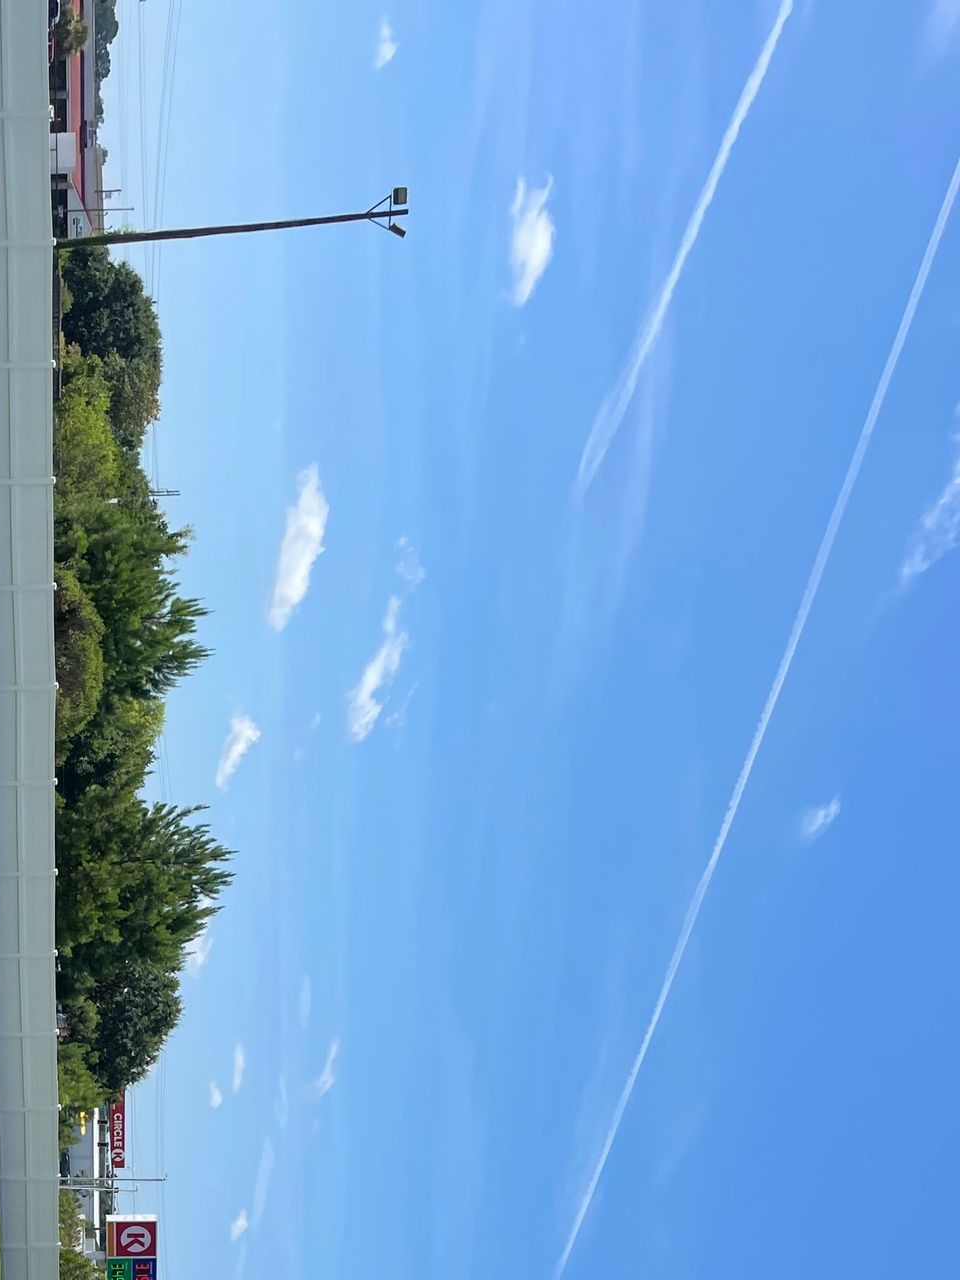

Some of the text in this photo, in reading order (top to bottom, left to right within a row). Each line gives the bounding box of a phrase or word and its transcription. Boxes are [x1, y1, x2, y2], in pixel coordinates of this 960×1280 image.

[112, 1113, 124, 1161] CIRCLE K
[121, 1231, 147, 1252] K
